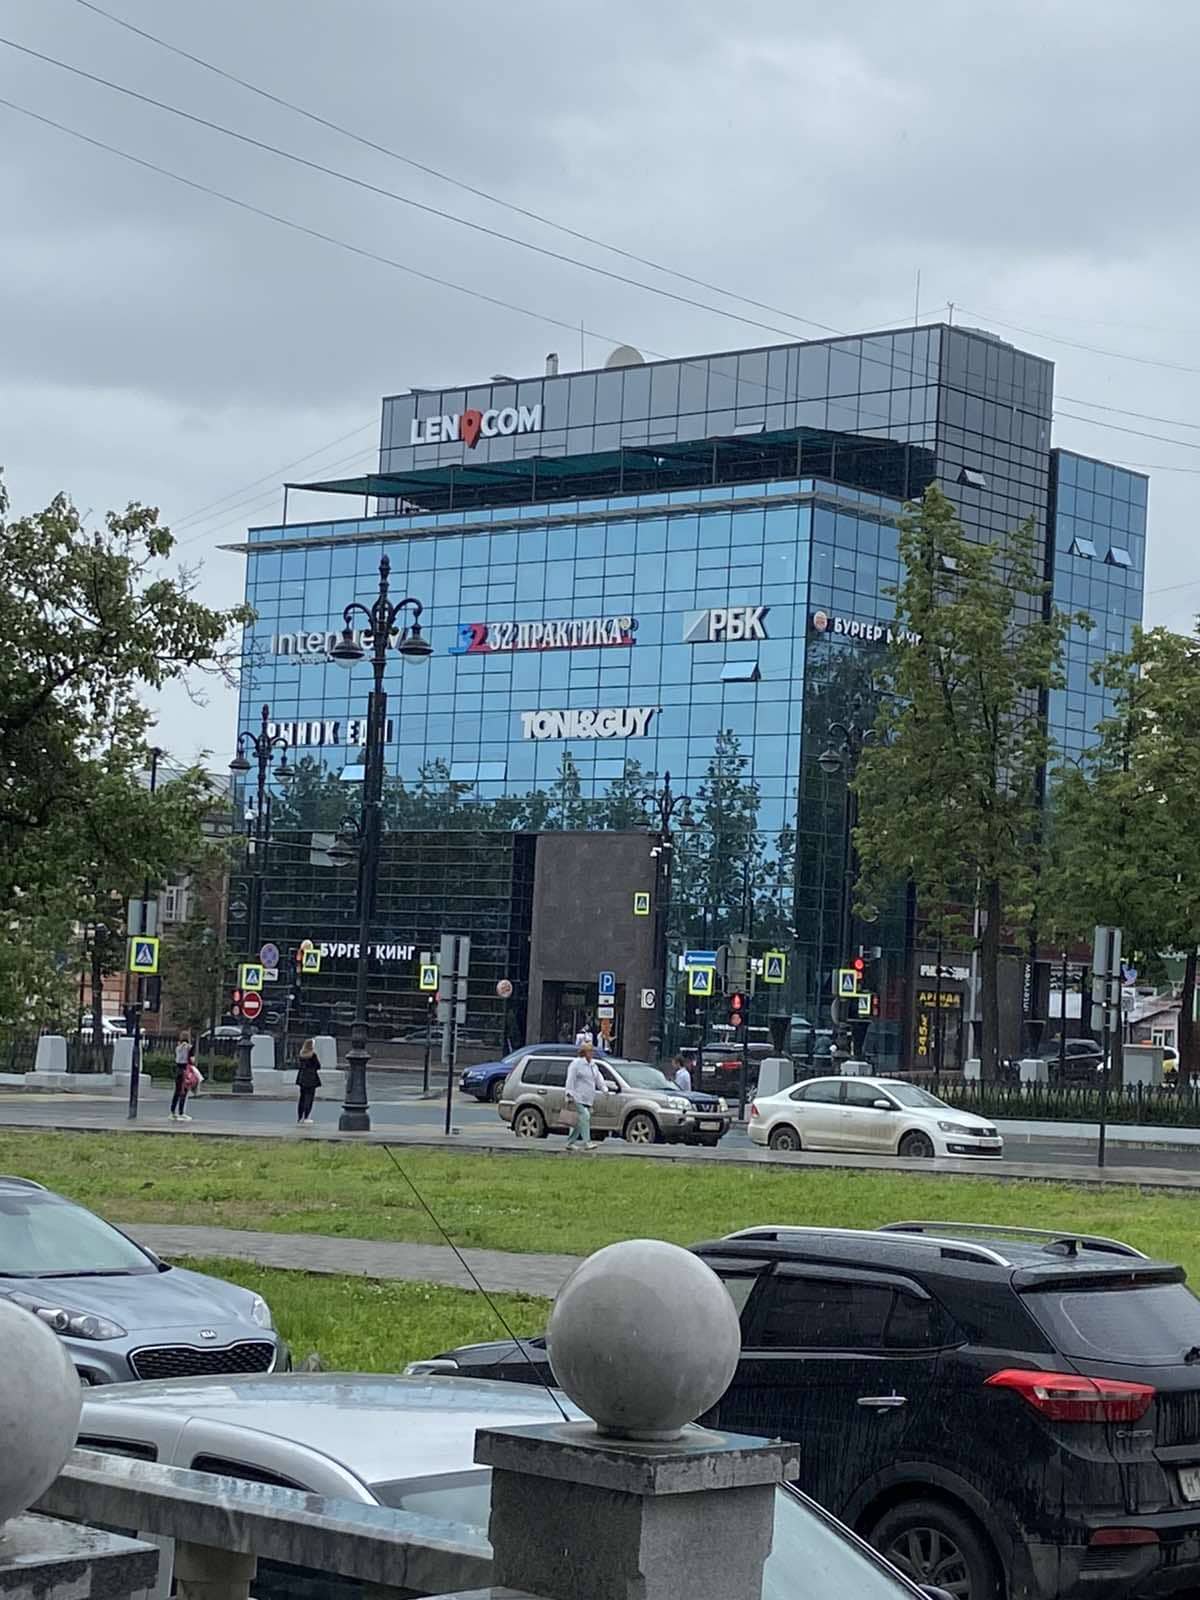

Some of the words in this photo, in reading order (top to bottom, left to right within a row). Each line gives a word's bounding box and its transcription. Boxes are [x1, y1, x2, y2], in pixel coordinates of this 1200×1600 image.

[709, 606, 767, 641] РБК
[834, 617, 882, 641] БУРГЕР
[521, 705, 656, 739] TONI&GUY
[375, 944, 416, 961] КИНГ
